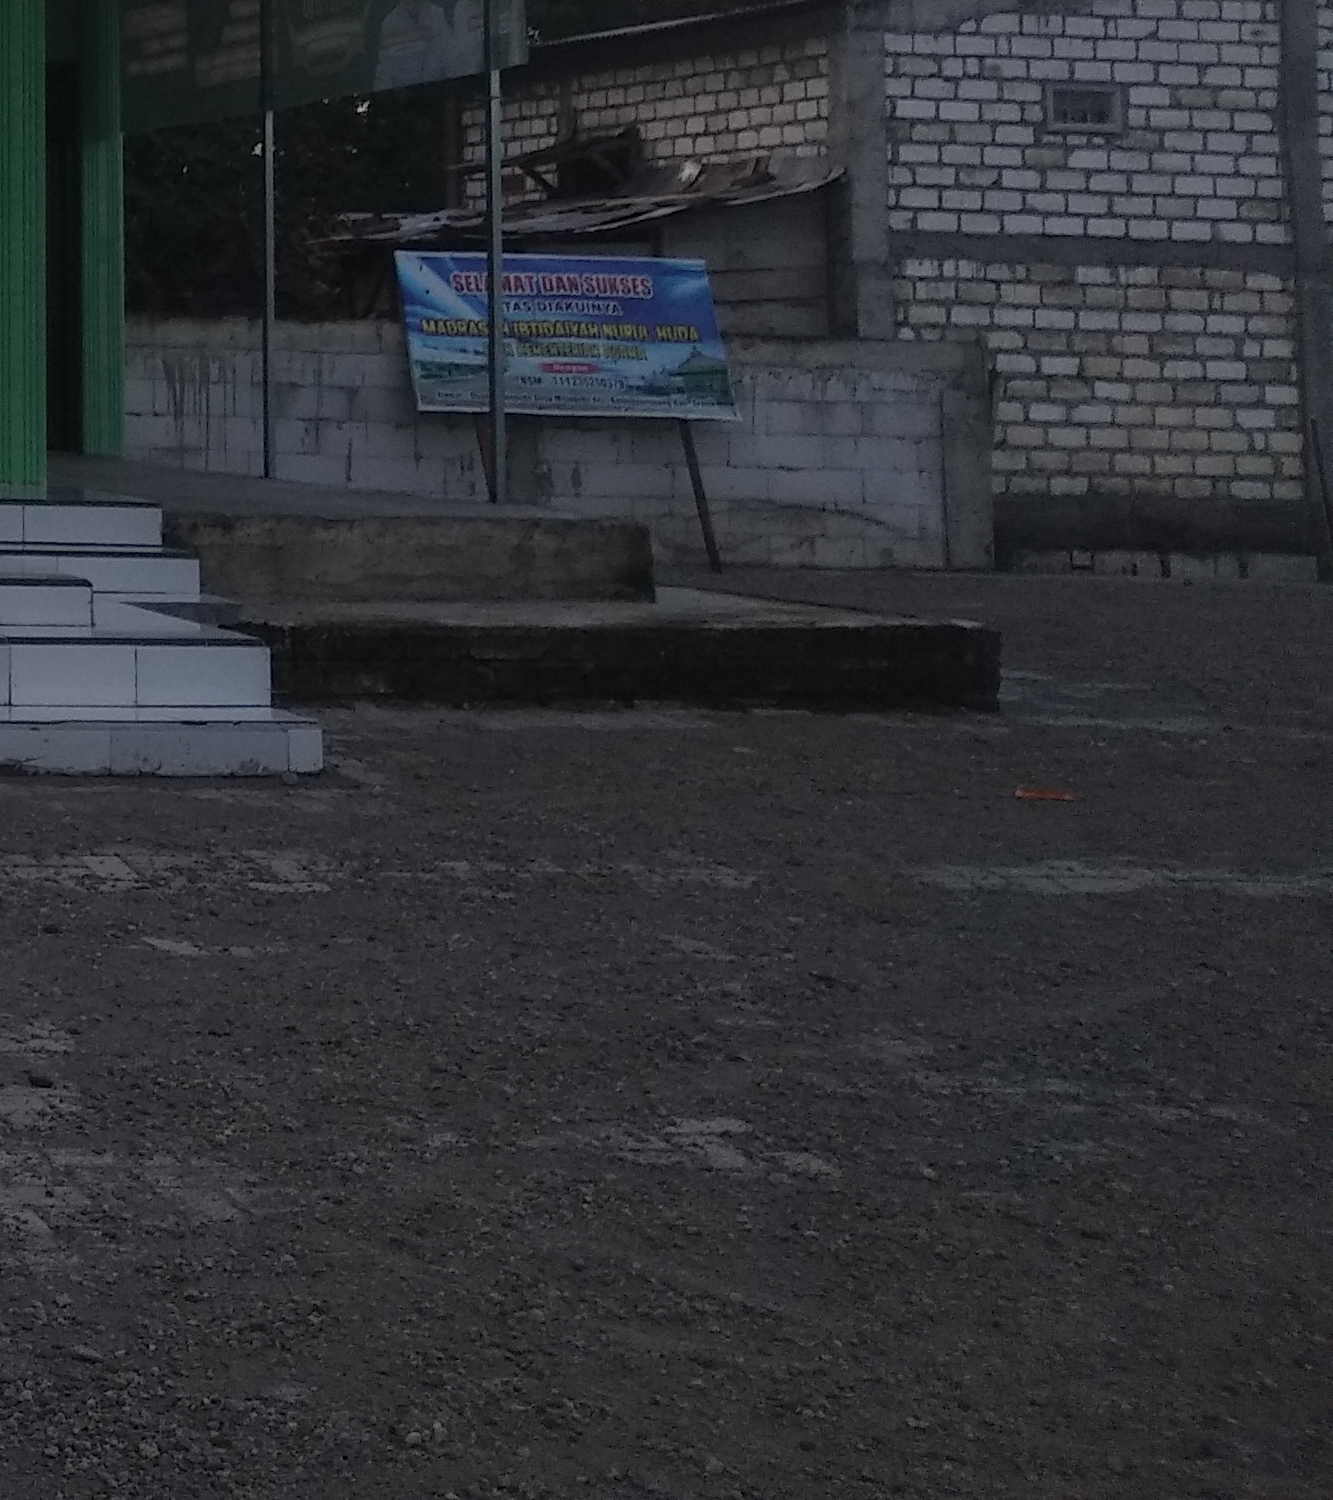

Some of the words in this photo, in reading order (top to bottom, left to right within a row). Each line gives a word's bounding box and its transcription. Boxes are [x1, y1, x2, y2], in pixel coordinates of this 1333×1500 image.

[540, 274, 580, 297] DAN
[582, 274, 653, 299] SUKSES
[655, 325, 699, 342] HUDA
